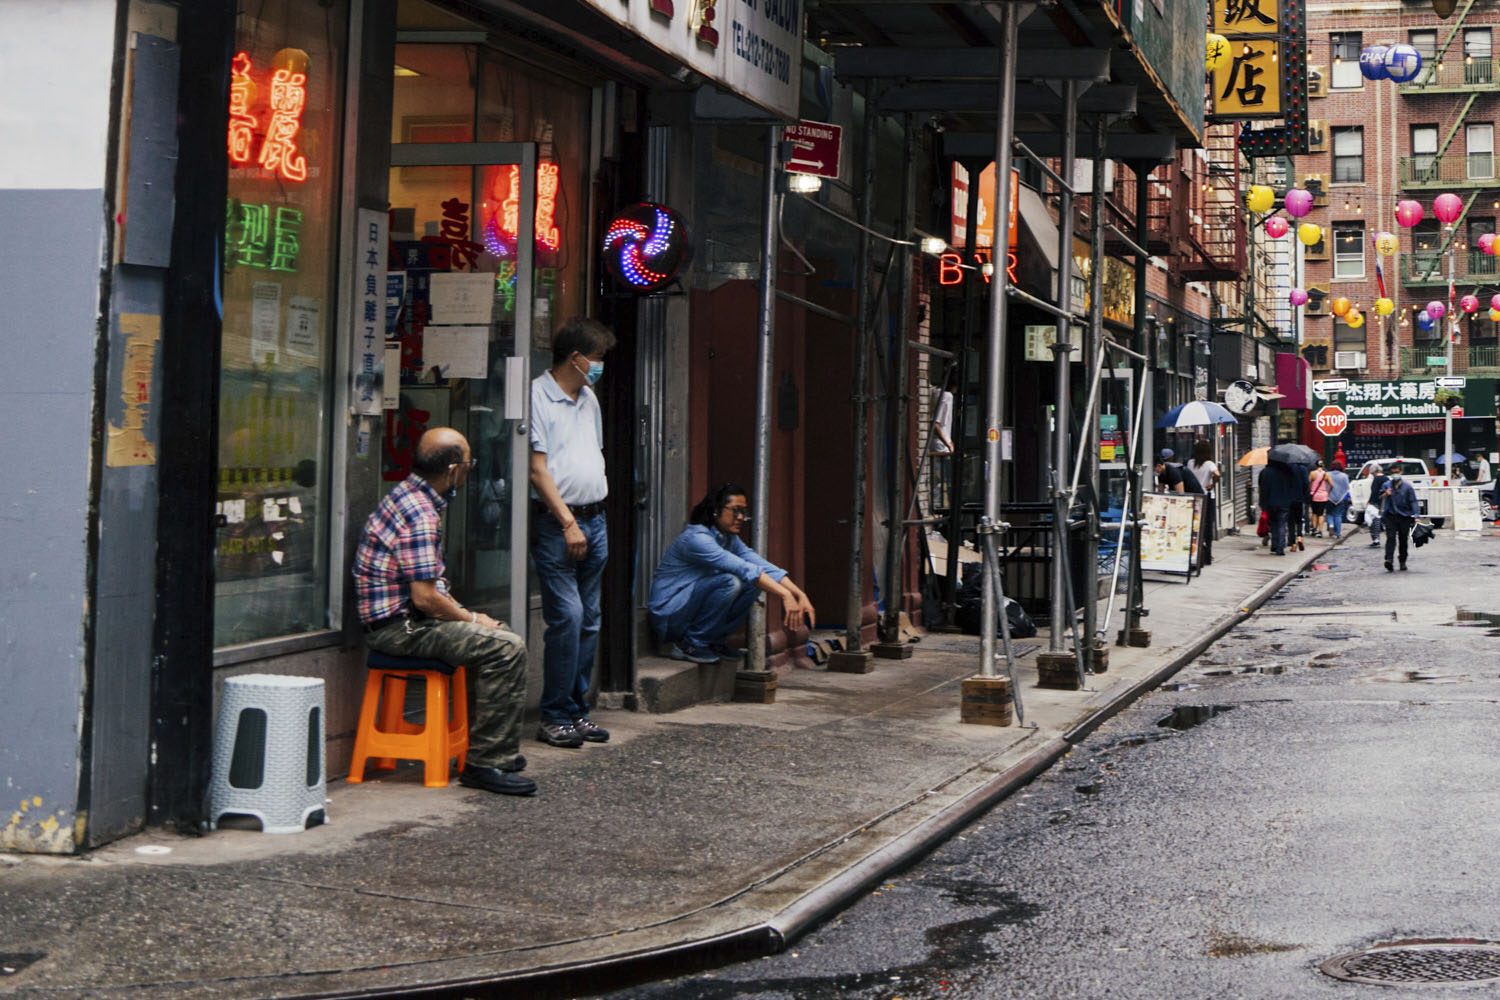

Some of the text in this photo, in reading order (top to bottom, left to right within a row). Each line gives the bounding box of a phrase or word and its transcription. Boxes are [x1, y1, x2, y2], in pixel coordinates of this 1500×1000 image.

[785, 125, 833, 141] NO STANDING
[1345, 404, 1400, 418] Paradigm
[1402, 403, 1440, 415] Health
[1318, 414, 1346, 428] STOP
[1360, 420, 1444, 435] GRAND OPENING
